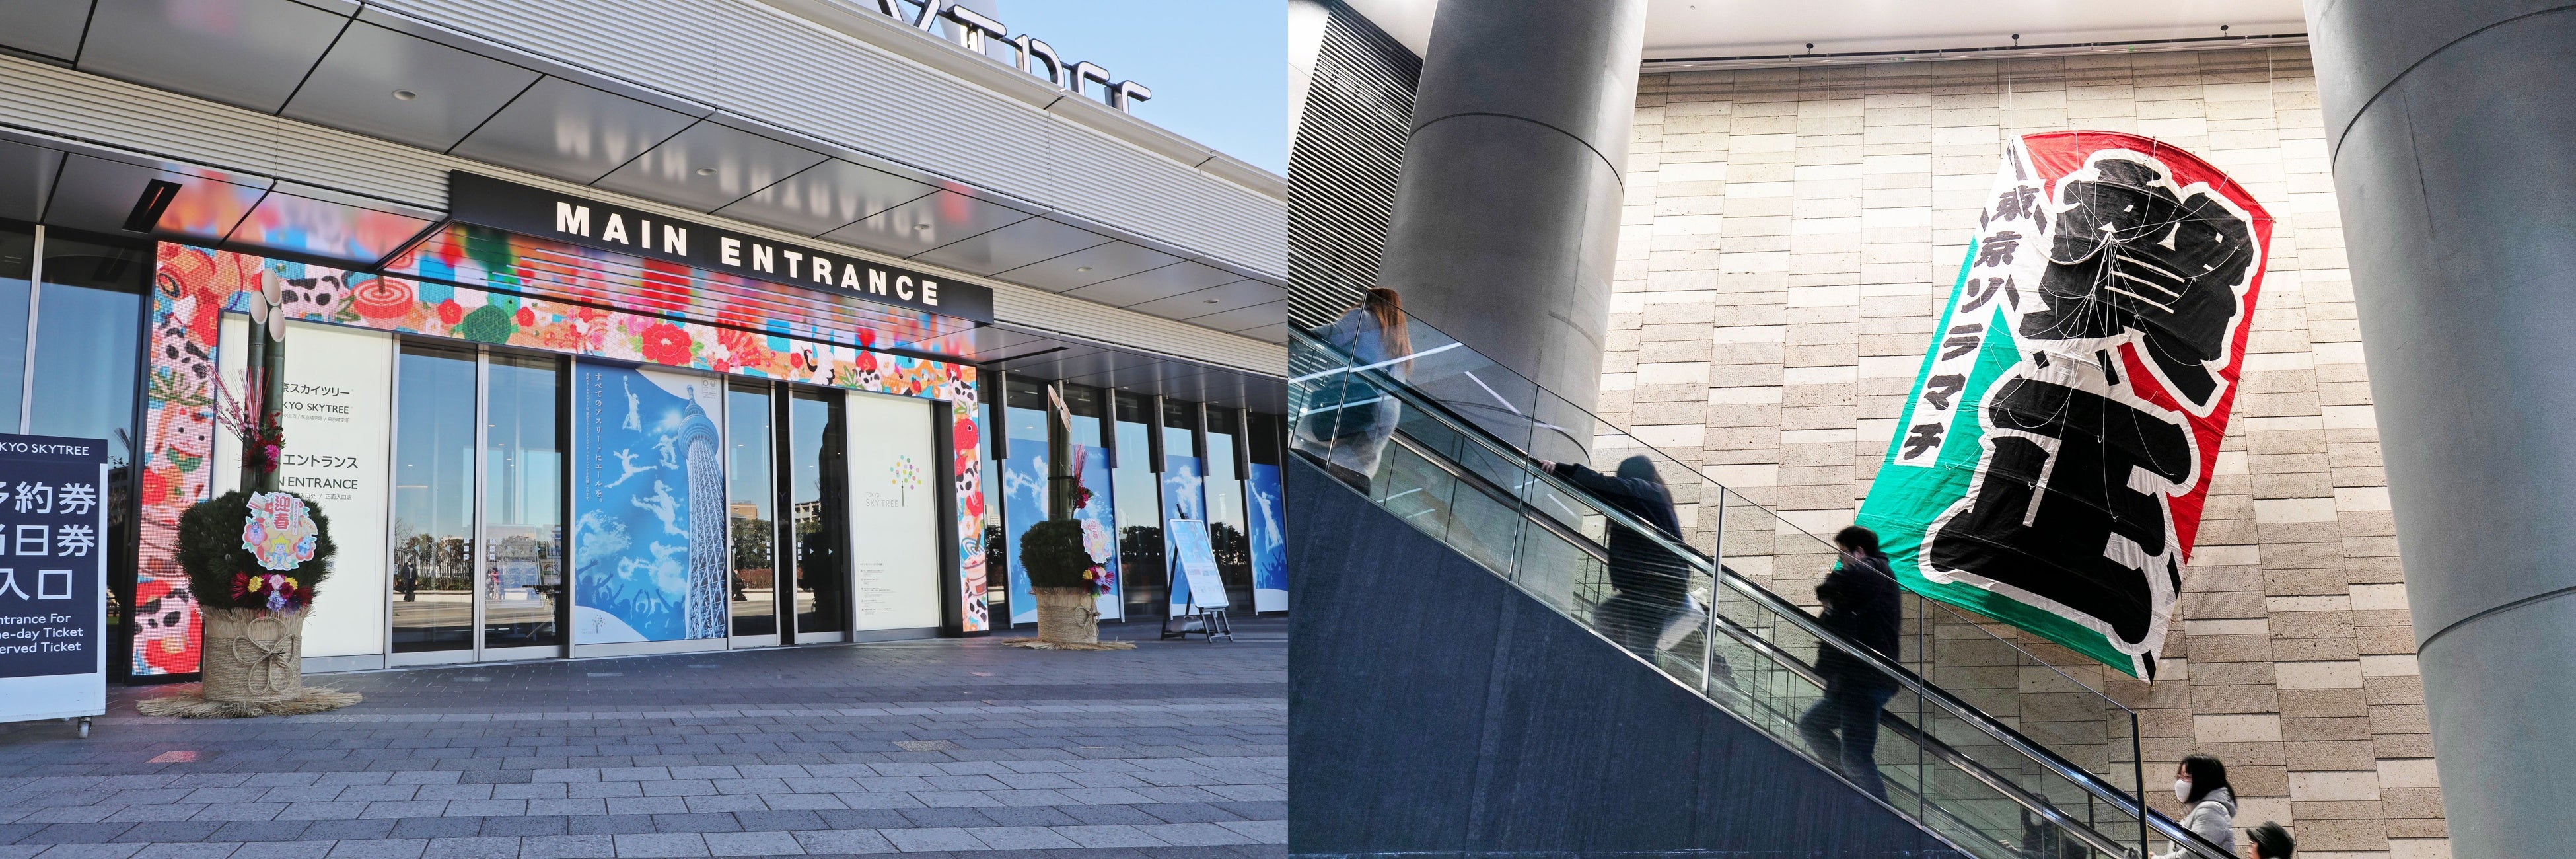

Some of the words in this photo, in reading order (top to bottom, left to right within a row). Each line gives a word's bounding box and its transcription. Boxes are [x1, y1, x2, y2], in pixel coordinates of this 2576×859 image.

[557, 202, 688, 257] MAIN
[721, 237, 939, 306] ENTRANCE
[1904, 184, 2042, 461] 東京ソラマチ
[284, 401, 303, 410] KYO
[307, 403, 349, 414] SKYTREE
[1930, 157, 2255, 644] 賀正
[0, 442, 28, 453] KYO
[32, 443, 90, 456] SKYTREE
[283, 454, 359, 469] エントランス
[288, 476, 358, 490] ENTRANCE
[0, 480, 96, 515] 約券
[273, 495, 291, 529] 迎春
[0, 524, 95, 557] 日券
[0, 568, 73, 601] 入口
[50, 613, 71, 623] For
[0, 628, 40, 641] e-day
[43, 627, 84, 638] Ticket
[0, 642, 37, 654] erved
[41, 641, 82, 652] Ticket
